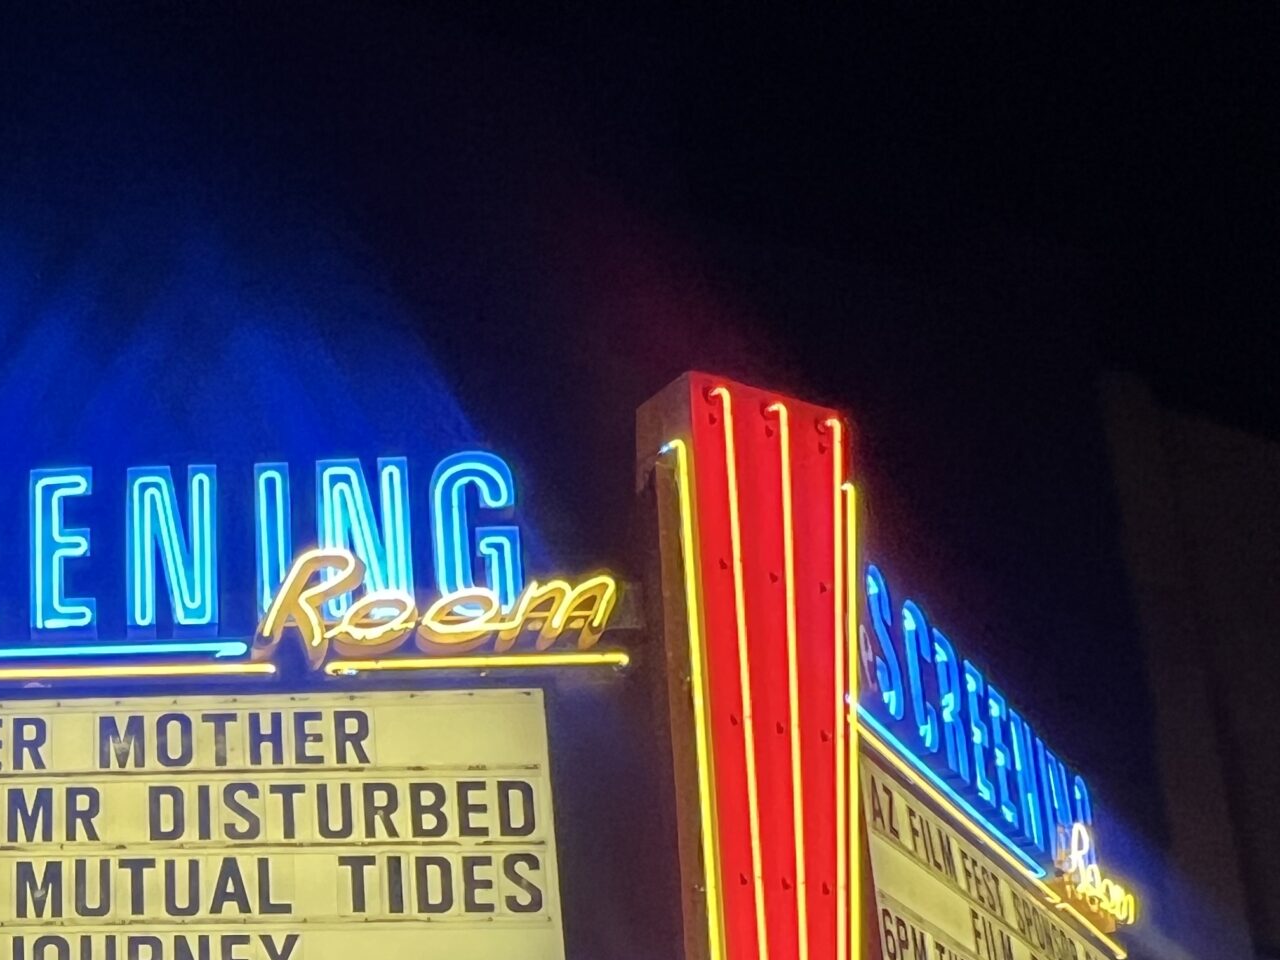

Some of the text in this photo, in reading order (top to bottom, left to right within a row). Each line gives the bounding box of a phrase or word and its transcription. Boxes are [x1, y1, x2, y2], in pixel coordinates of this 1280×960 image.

[253, 547, 618, 668] Room
[97, 710, 372, 770] MOTHER
[6, 786, 101, 843] MR
[148, 779, 537, 841] DISTURBED
[870, 775, 900, 841] AZ
[906, 803, 957, 883] FILM
[960, 848, 1005, 919] FEST
[15, 855, 293, 919] MUTUAL
[338, 852, 543, 914] TIDES
